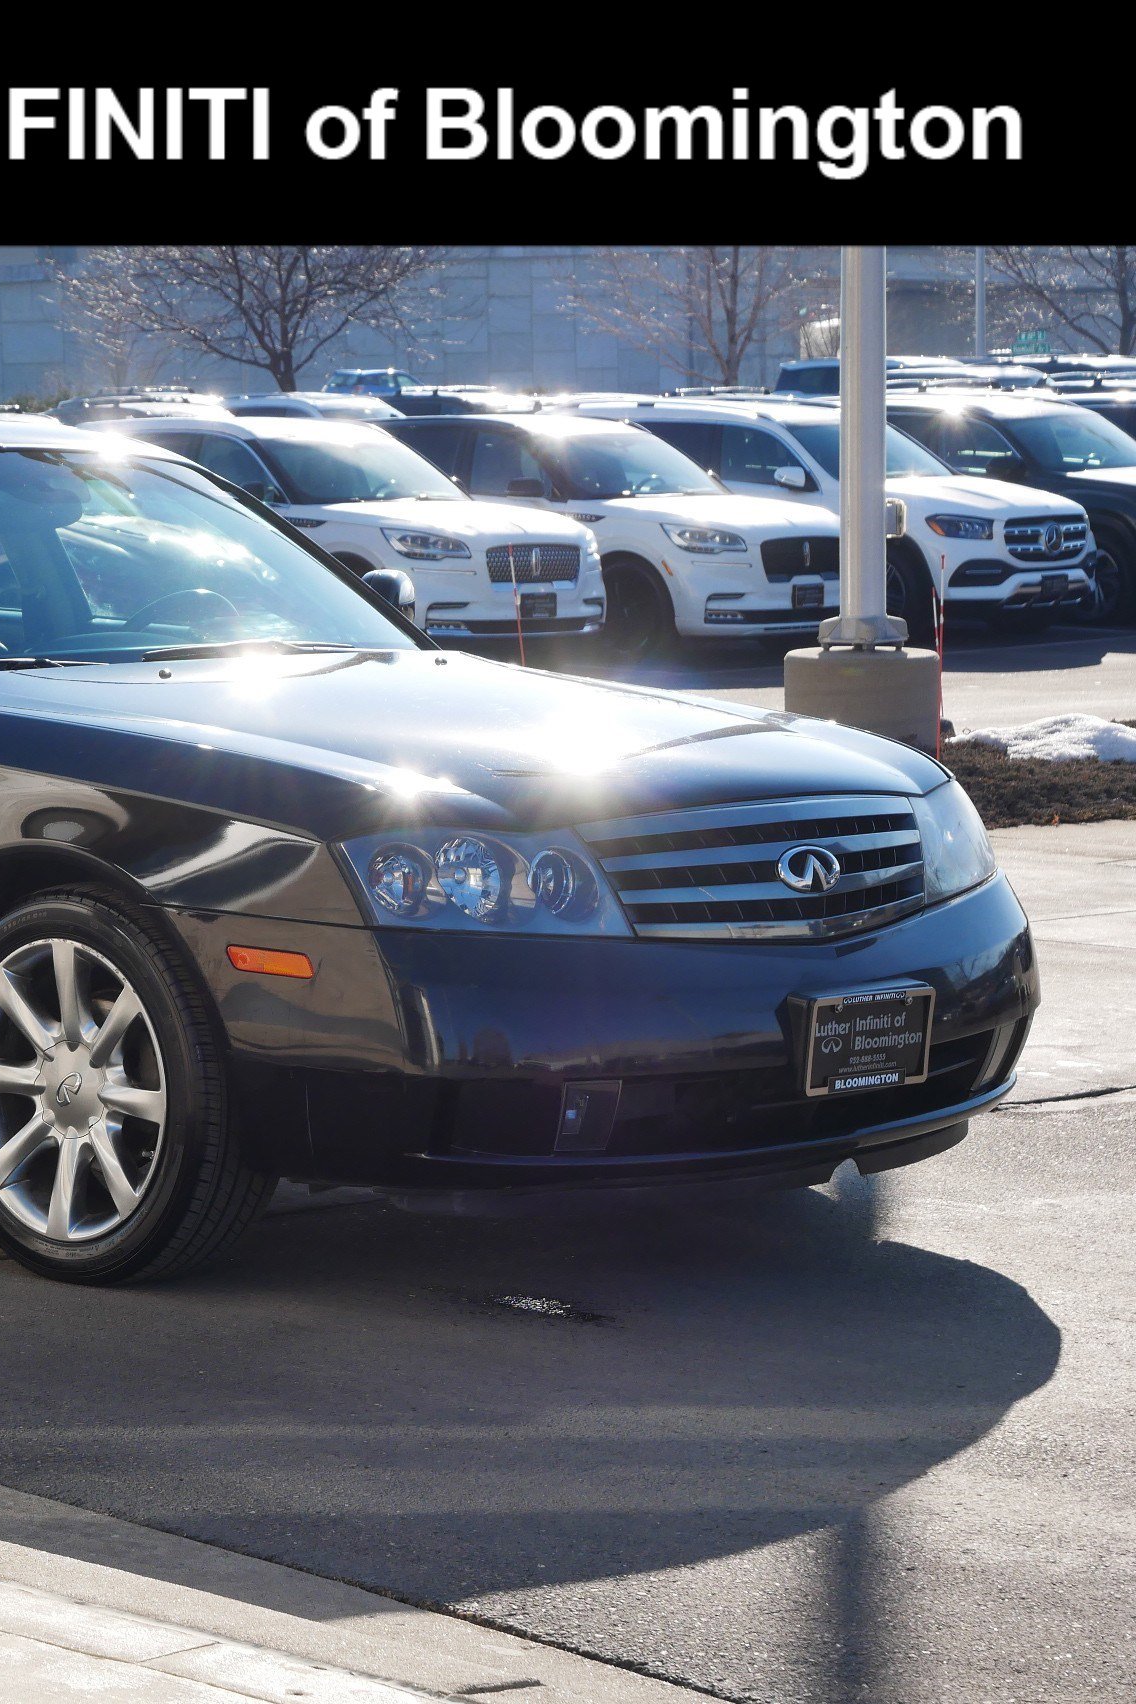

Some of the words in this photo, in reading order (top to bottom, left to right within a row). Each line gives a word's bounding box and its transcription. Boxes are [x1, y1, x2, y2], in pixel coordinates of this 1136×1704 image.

[852, 995, 873, 1004] LUTHER
[815, 1020, 851, 1038] Luther
[855, 1013, 892, 1032] Infiniti
[894, 1011, 907, 1028] of
[854, 1031, 923, 1051] Bloomington
[834, 1073, 900, 1090] BLOOMINGTON
